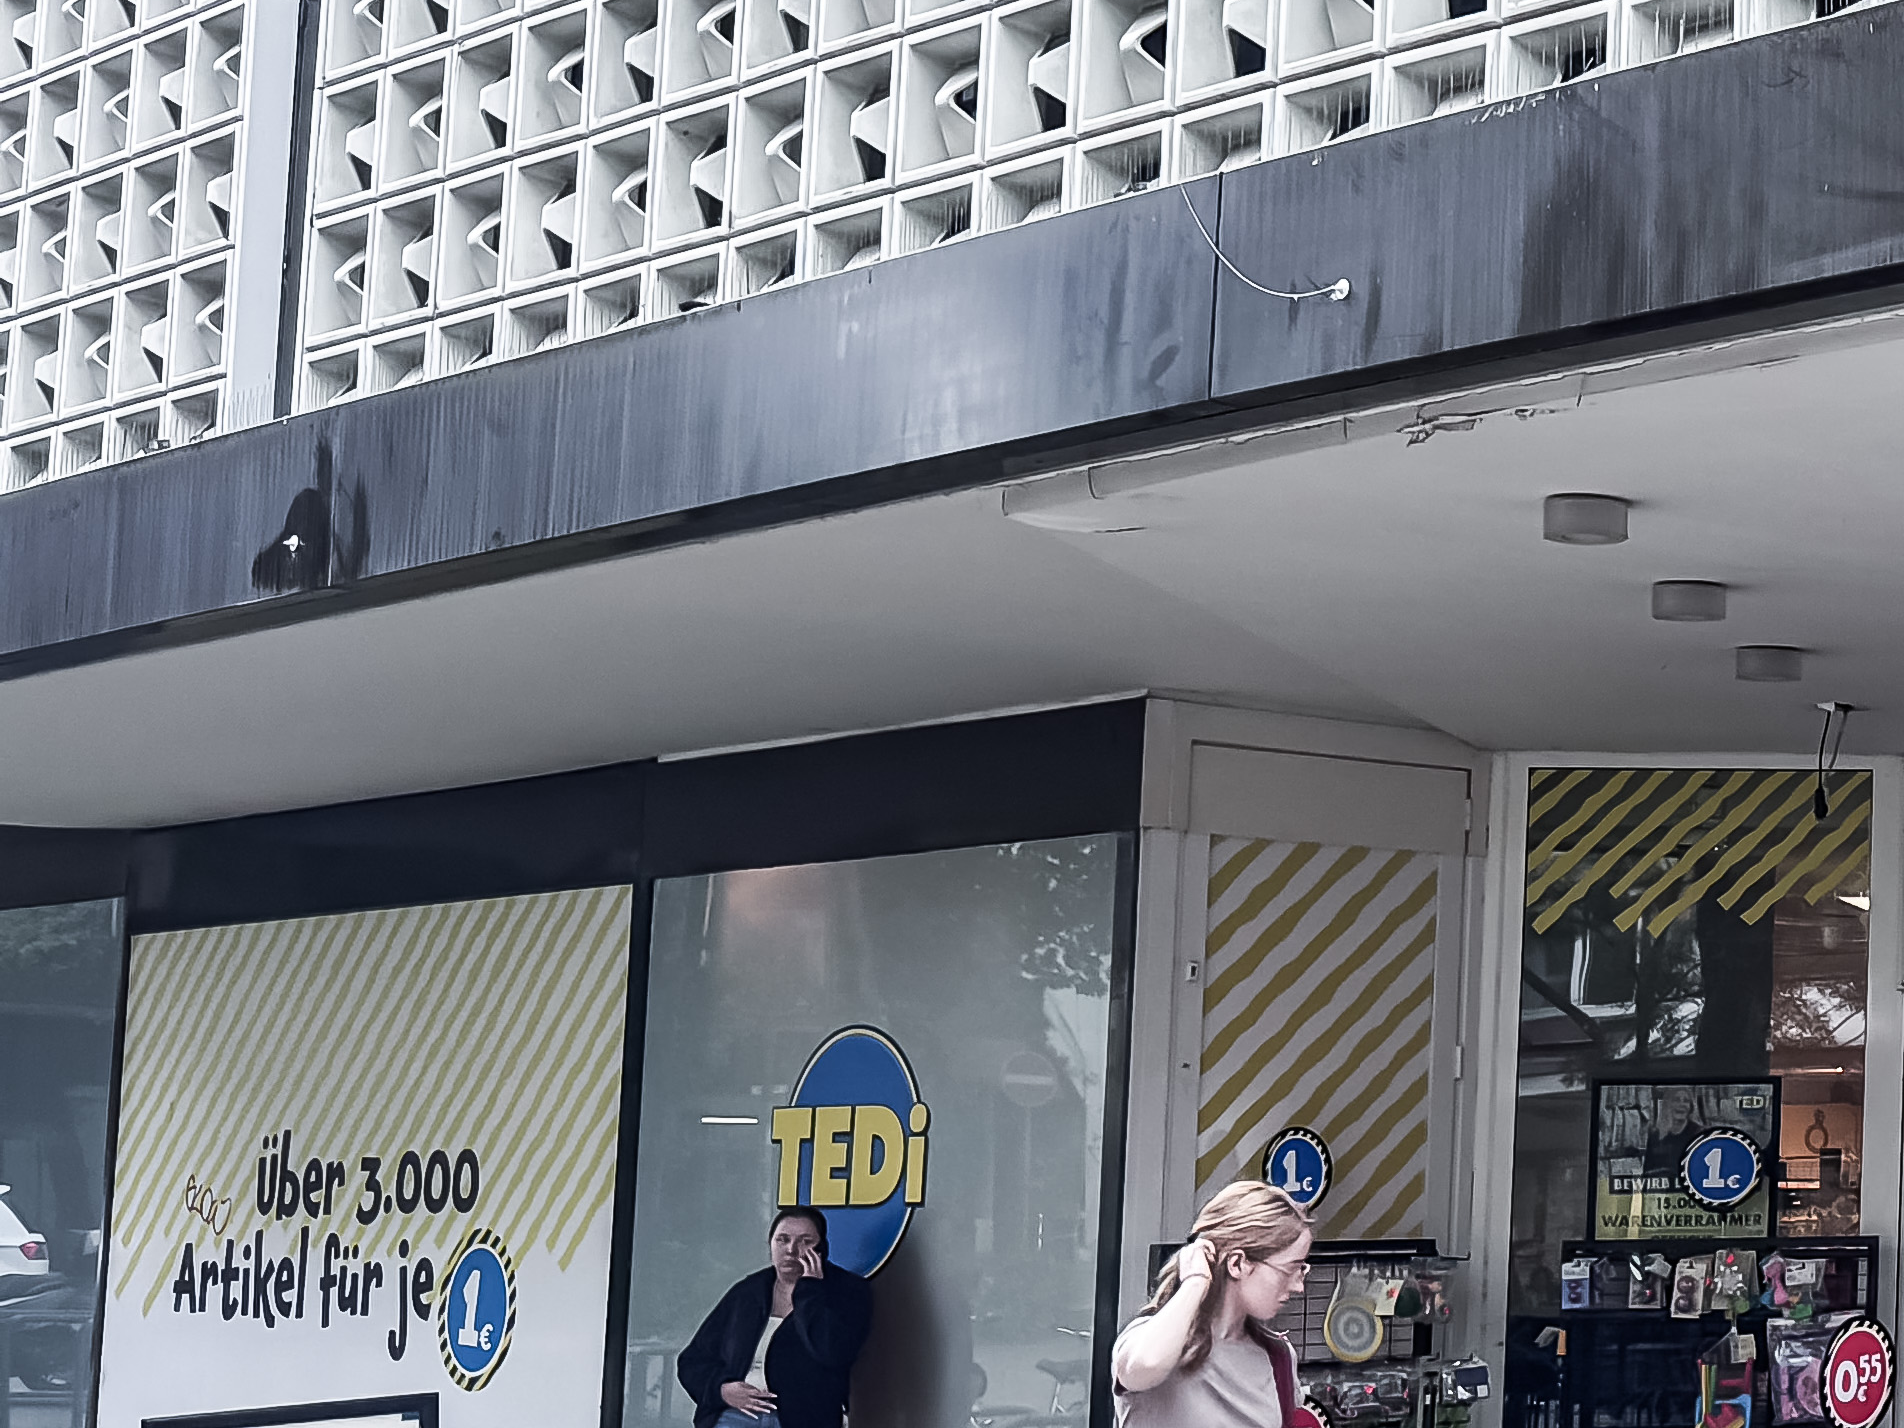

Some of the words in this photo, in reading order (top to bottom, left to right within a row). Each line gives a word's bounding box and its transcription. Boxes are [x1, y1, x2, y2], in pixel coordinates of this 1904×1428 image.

[355, 1147, 481, 1226] 3.000
[770, 1101, 930, 1208] TEDi
[172, 1224, 311, 1329] Artikel
[319, 1231, 384, 1329] für
[387, 1238, 436, 1362] je
